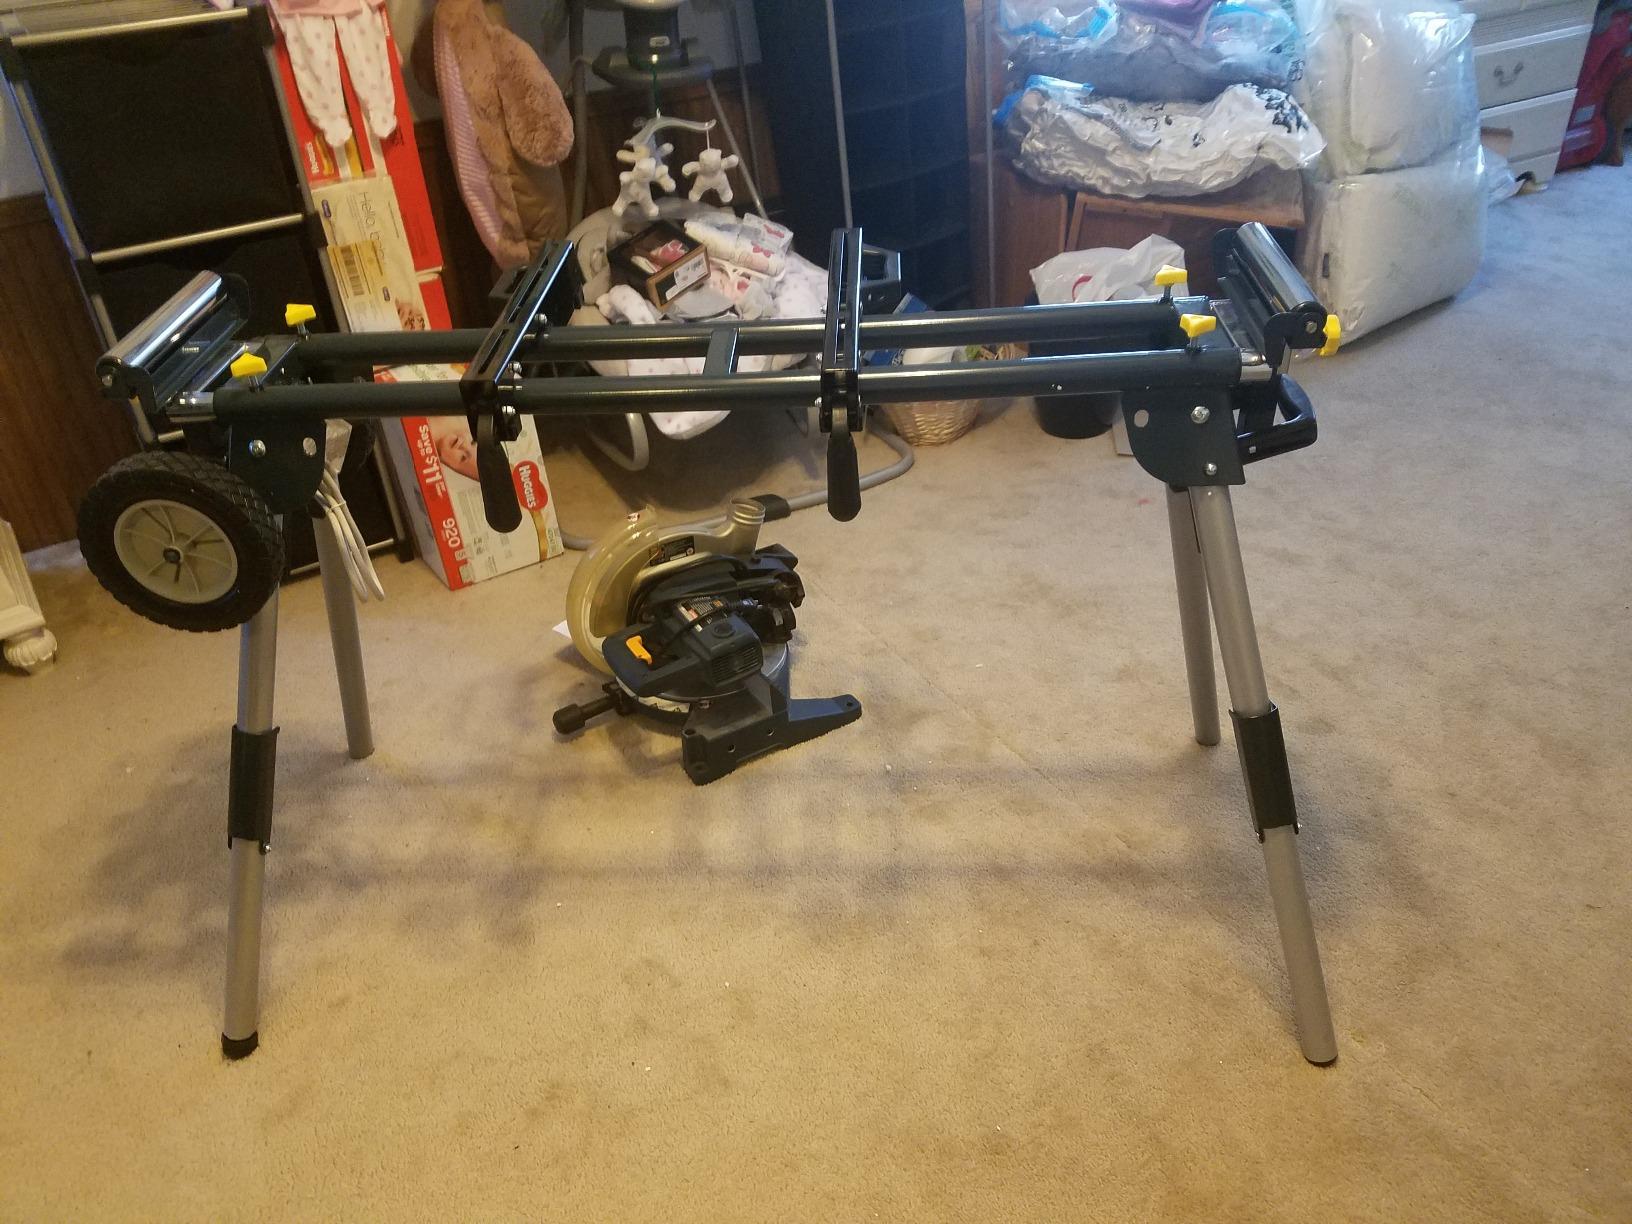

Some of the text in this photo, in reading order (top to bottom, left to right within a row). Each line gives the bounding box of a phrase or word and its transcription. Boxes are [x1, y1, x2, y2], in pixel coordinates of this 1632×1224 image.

[419, 424, 433, 455] Save
[423, 456, 442, 485] $11
[518, 464, 537, 509] HUGGIES
[442, 517, 461, 548] 920
